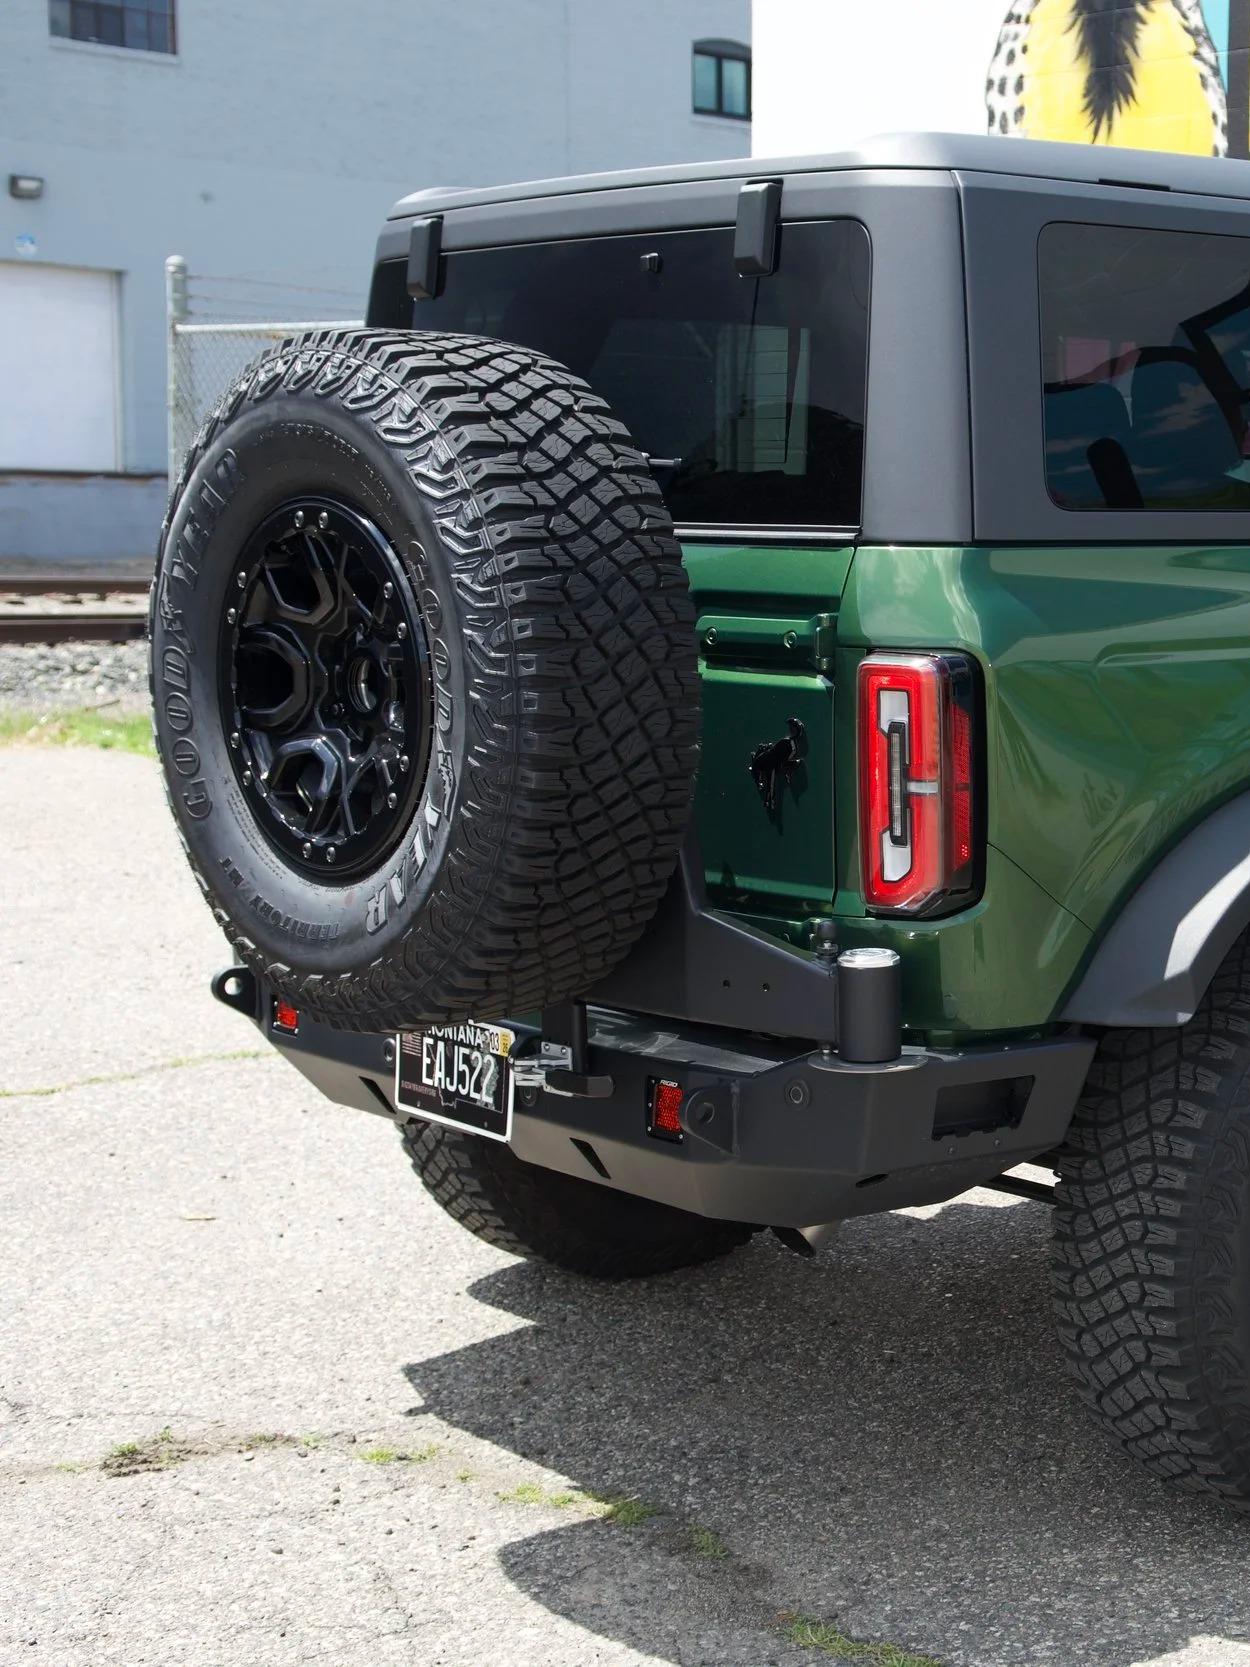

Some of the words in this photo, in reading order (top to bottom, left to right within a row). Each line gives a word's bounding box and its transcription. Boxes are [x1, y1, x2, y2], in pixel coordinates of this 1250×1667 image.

[249, 894, 340, 940] TERRITORY
[422, 1036, 494, 1103] EAJ522
[660, 1080, 678, 1088] RIGID
